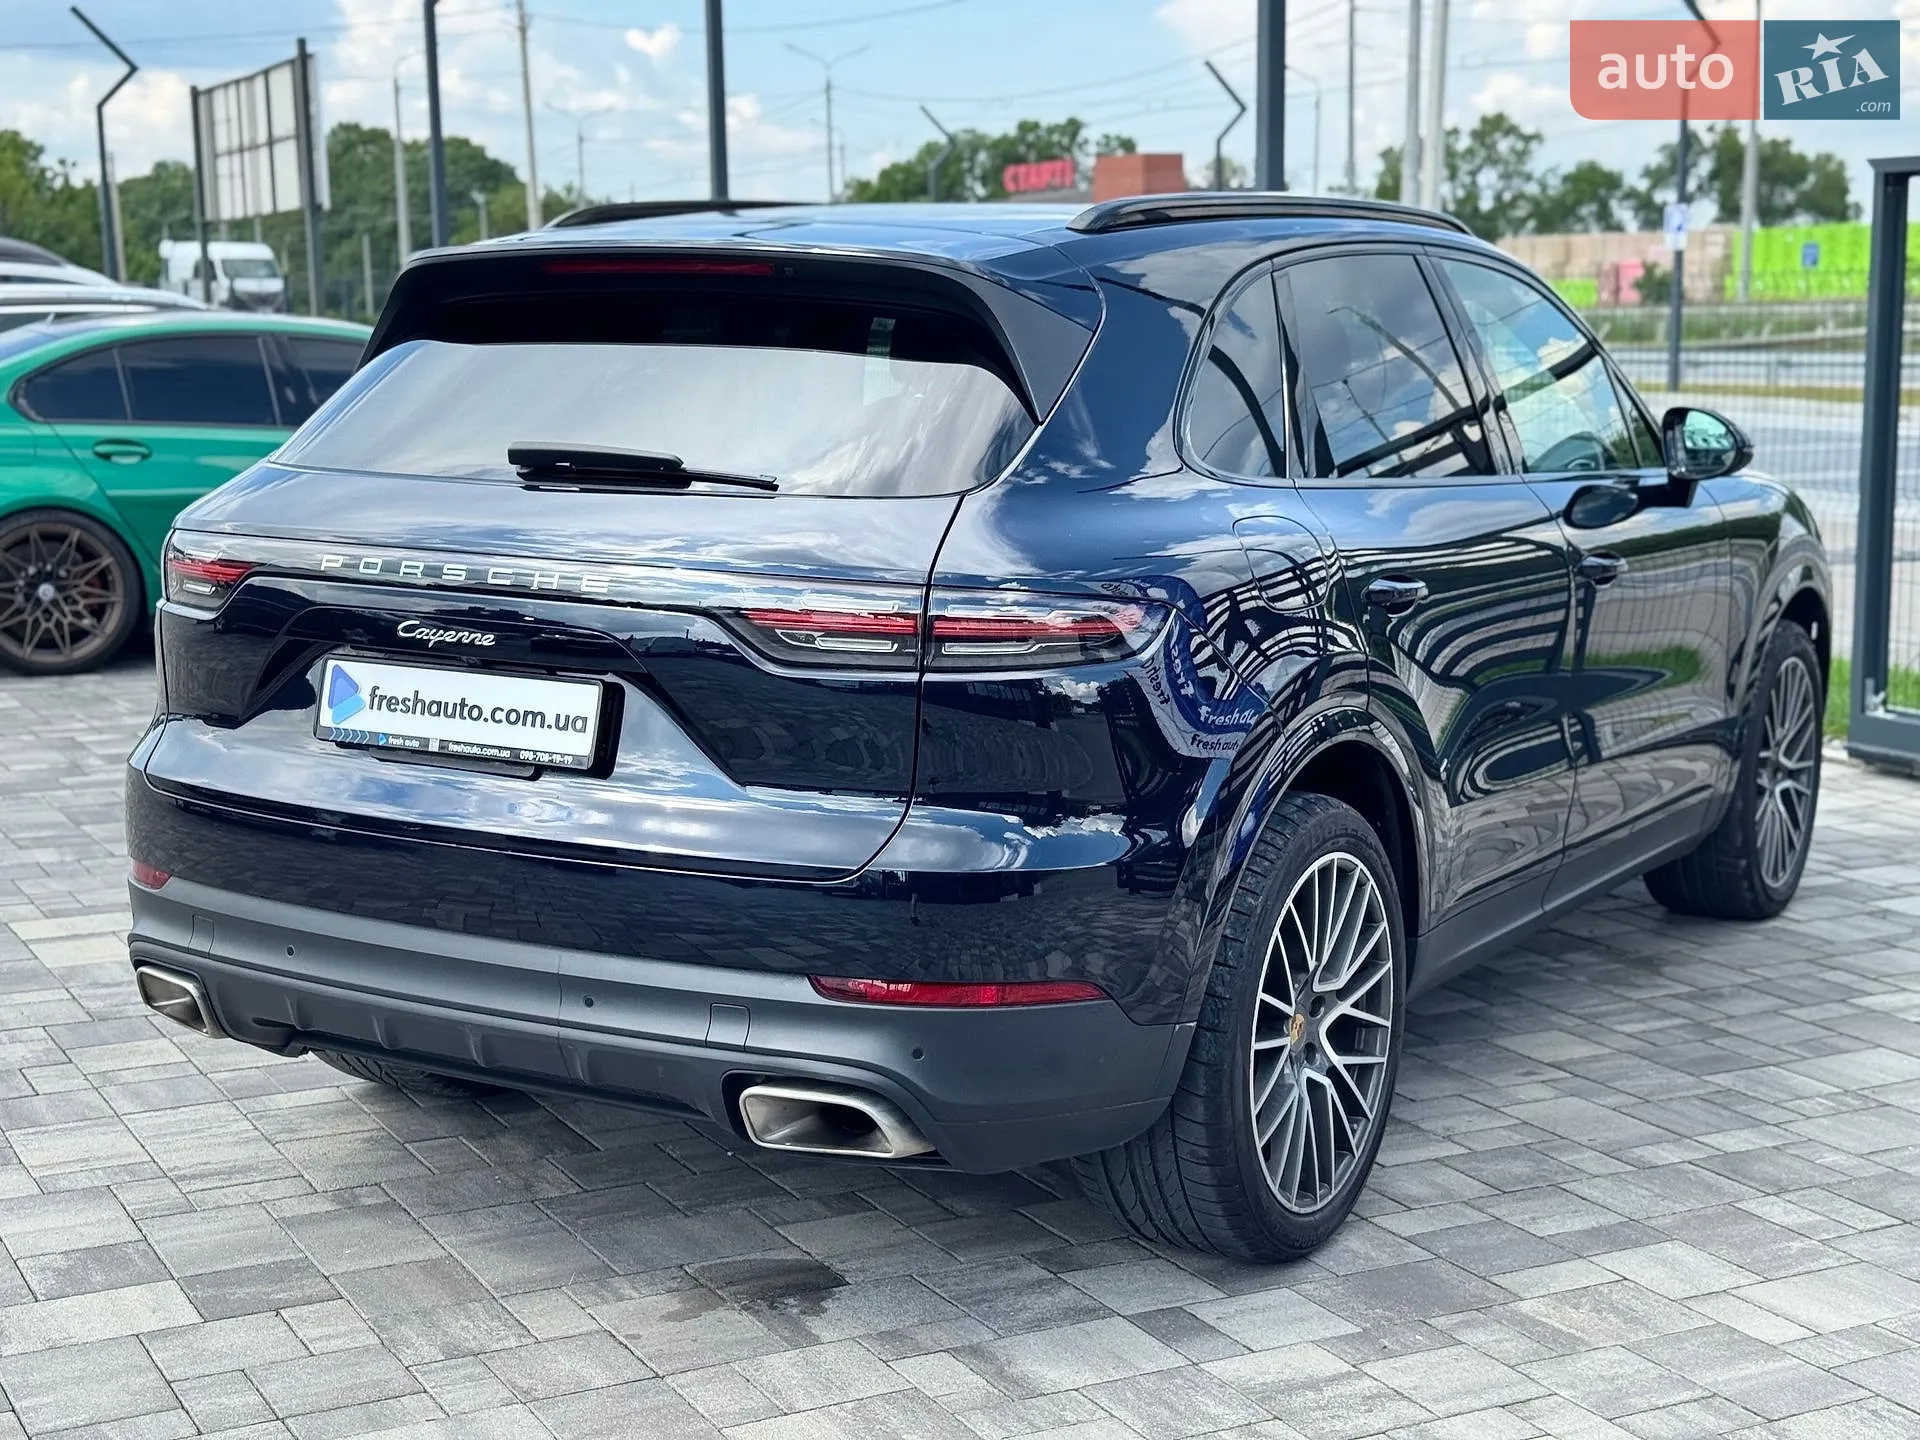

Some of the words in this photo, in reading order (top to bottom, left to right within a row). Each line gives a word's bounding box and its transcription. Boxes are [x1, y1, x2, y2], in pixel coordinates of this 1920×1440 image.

[320, 554, 611, 593] PORSCHE
[396, 620, 496, 648] Cayenne
[368, 686, 588, 733] freshauto.com.ua
[388, 735, 404, 746] fresh
[405, 739, 420, 748] auto
[448, 742, 511, 758] freshauto.com.ua
